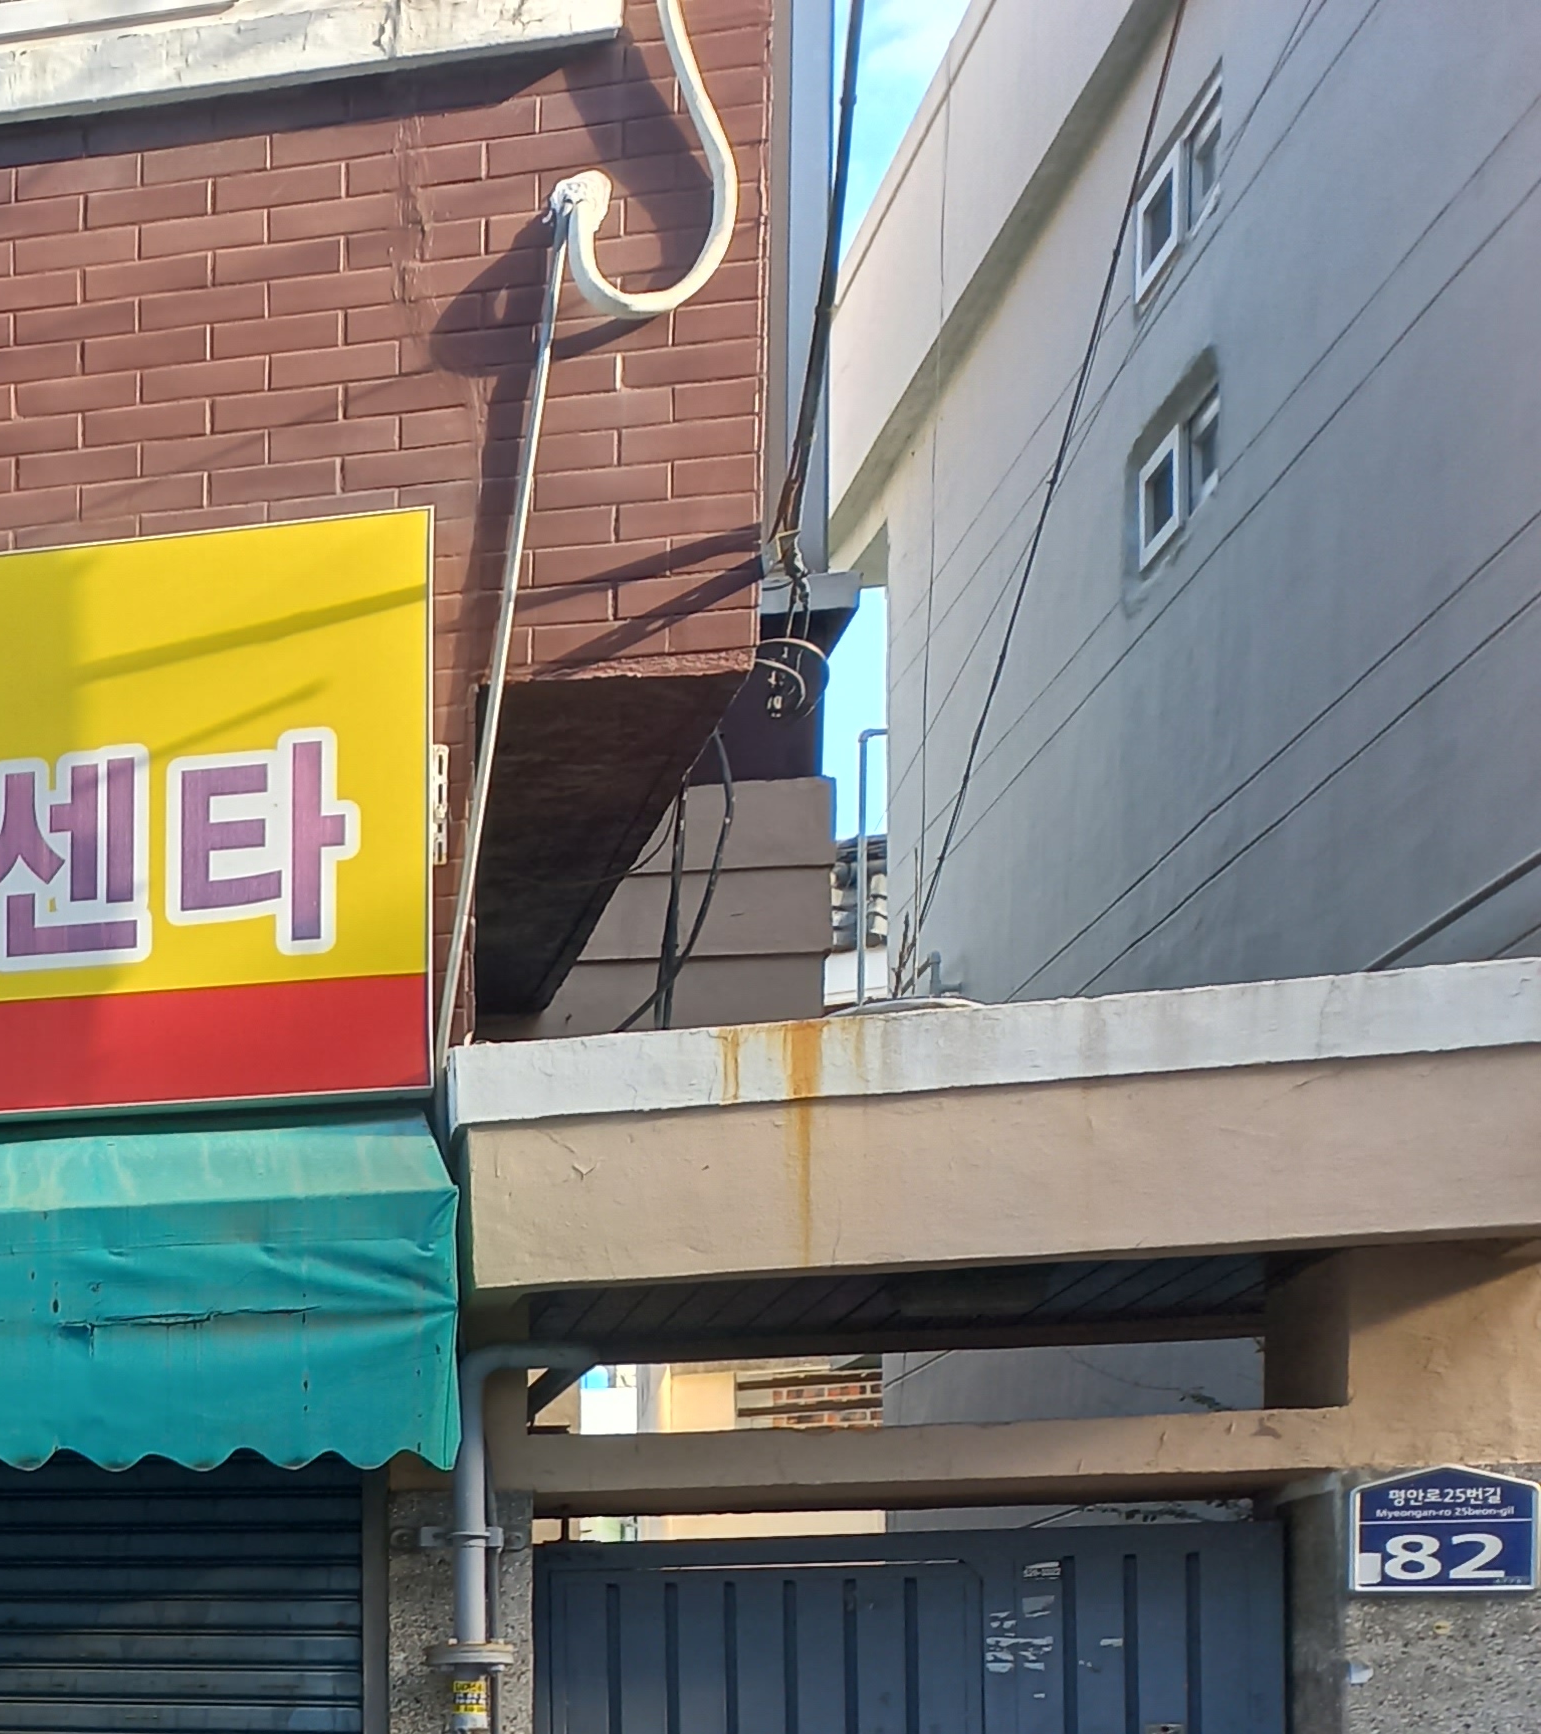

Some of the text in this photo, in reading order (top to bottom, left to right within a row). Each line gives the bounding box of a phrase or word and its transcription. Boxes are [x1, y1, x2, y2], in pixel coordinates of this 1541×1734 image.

[1388, 1486, 1501, 1506] 명안로25번길
[1375, 1505, 1515, 1519] Myeongan-ro 25beon-gil
[1384, 1532, 1506, 1581] 82
